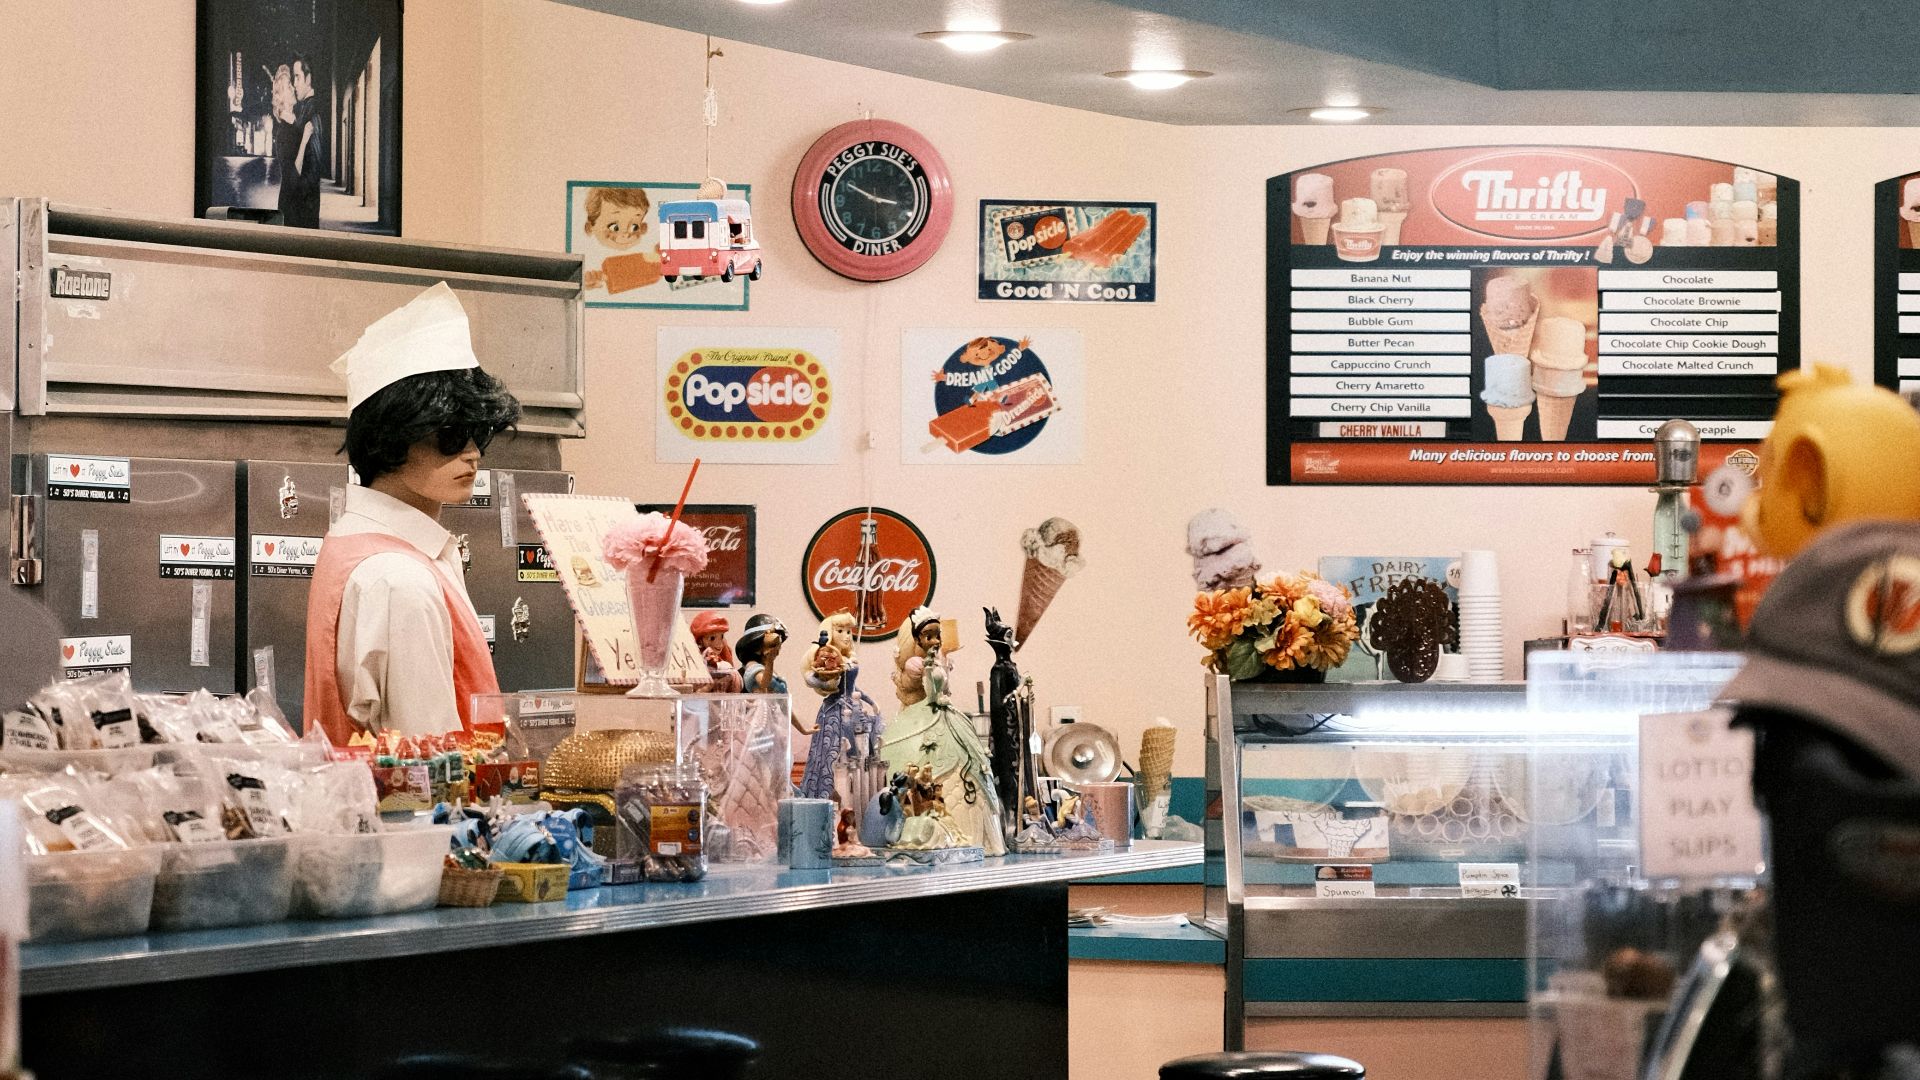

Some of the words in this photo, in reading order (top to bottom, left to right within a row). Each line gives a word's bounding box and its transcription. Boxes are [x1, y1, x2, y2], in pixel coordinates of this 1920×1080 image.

[827, 143, 875, 177] PEGGY
[880, 143, 918, 171] SUE'S
[1462, 170, 1607, 220] Thrifty
[853, 239, 903, 256] DINER
[1392, 250, 1422, 262] Enjoy
[1425, 250, 1444, 260] the
[1446, 250, 1490, 262] winning
[1492, 250, 1530, 260] flavors
[1532, 250, 1546, 262] of
[1547, 250, 1584, 262] Thrifty
[1351, 274, 1388, 283] Banana
[1392, 274, 1411, 283] Nut
[1662, 275, 1714, 284] Chocolate
[996, 281, 1053, 298] Good
[1087, 284, 1137, 300] Cool
[1348, 296, 1375, 305] Black
[1379, 296, 1414, 306] Cherry
[1644, 297, 1694, 306] Chocolate
[1698, 297, 1741, 306] Brownie
[1348, 317, 1384, 326] Bubble
[1388, 317, 1413, 326] Gum
[1650, 318, 1701, 327] Chocolate
[1705, 318, 1729, 328] Chip
[1348, 339, 1379, 347] Butter
[1384, 339, 1415, 347] Pecan
[1611, 339, 1662, 348] Chocolate
[1666, 339, 1689, 349] Chip
[1692, 339, 1728, 348] Cookie
[1732, 339, 1766, 350] Dough
[706, 351, 723, 361] The
[724, 350, 757, 364] Original
[762, 351, 791, 361] Brand
[946, 348, 1023, 387] DREAMY-GOOD
[1331, 360, 1391, 371] Cappuccino
[1394, 360, 1431, 369] Crunch
[1622, 361, 1673, 370] Chocolate
[1677, 361, 1714, 370] Malted
[1717, 361, 1754, 370] Crunch
[1336, 381, 1371, 391] Cherry
[1375, 381, 1425, 390] Amaretto
[686, 373, 813, 413] Popsicle
[1331, 403, 1366, 413] Cherry
[1370, 403, 1393, 412] Chip
[1397, 403, 1431, 412] Vanilla
[1340, 425, 1378, 437] CHERRY
[1381, 425, 1422, 437] VANILLA
[1409, 449, 1446, 464] Many
[1450, 449, 1506, 461] delicious
[1509, 449, 1553, 461] flavors
[1556, 451, 1571, 461] to
[1574, 449, 1619, 461] choose
[520, 551, 525, 564] I
[1372, 561, 1427, 575] DAIRY
[1659, 757, 1744, 779] LOTTO
[1670, 797, 1733, 816] PLAY
[1323, 886, 1366, 897] Spumoni
